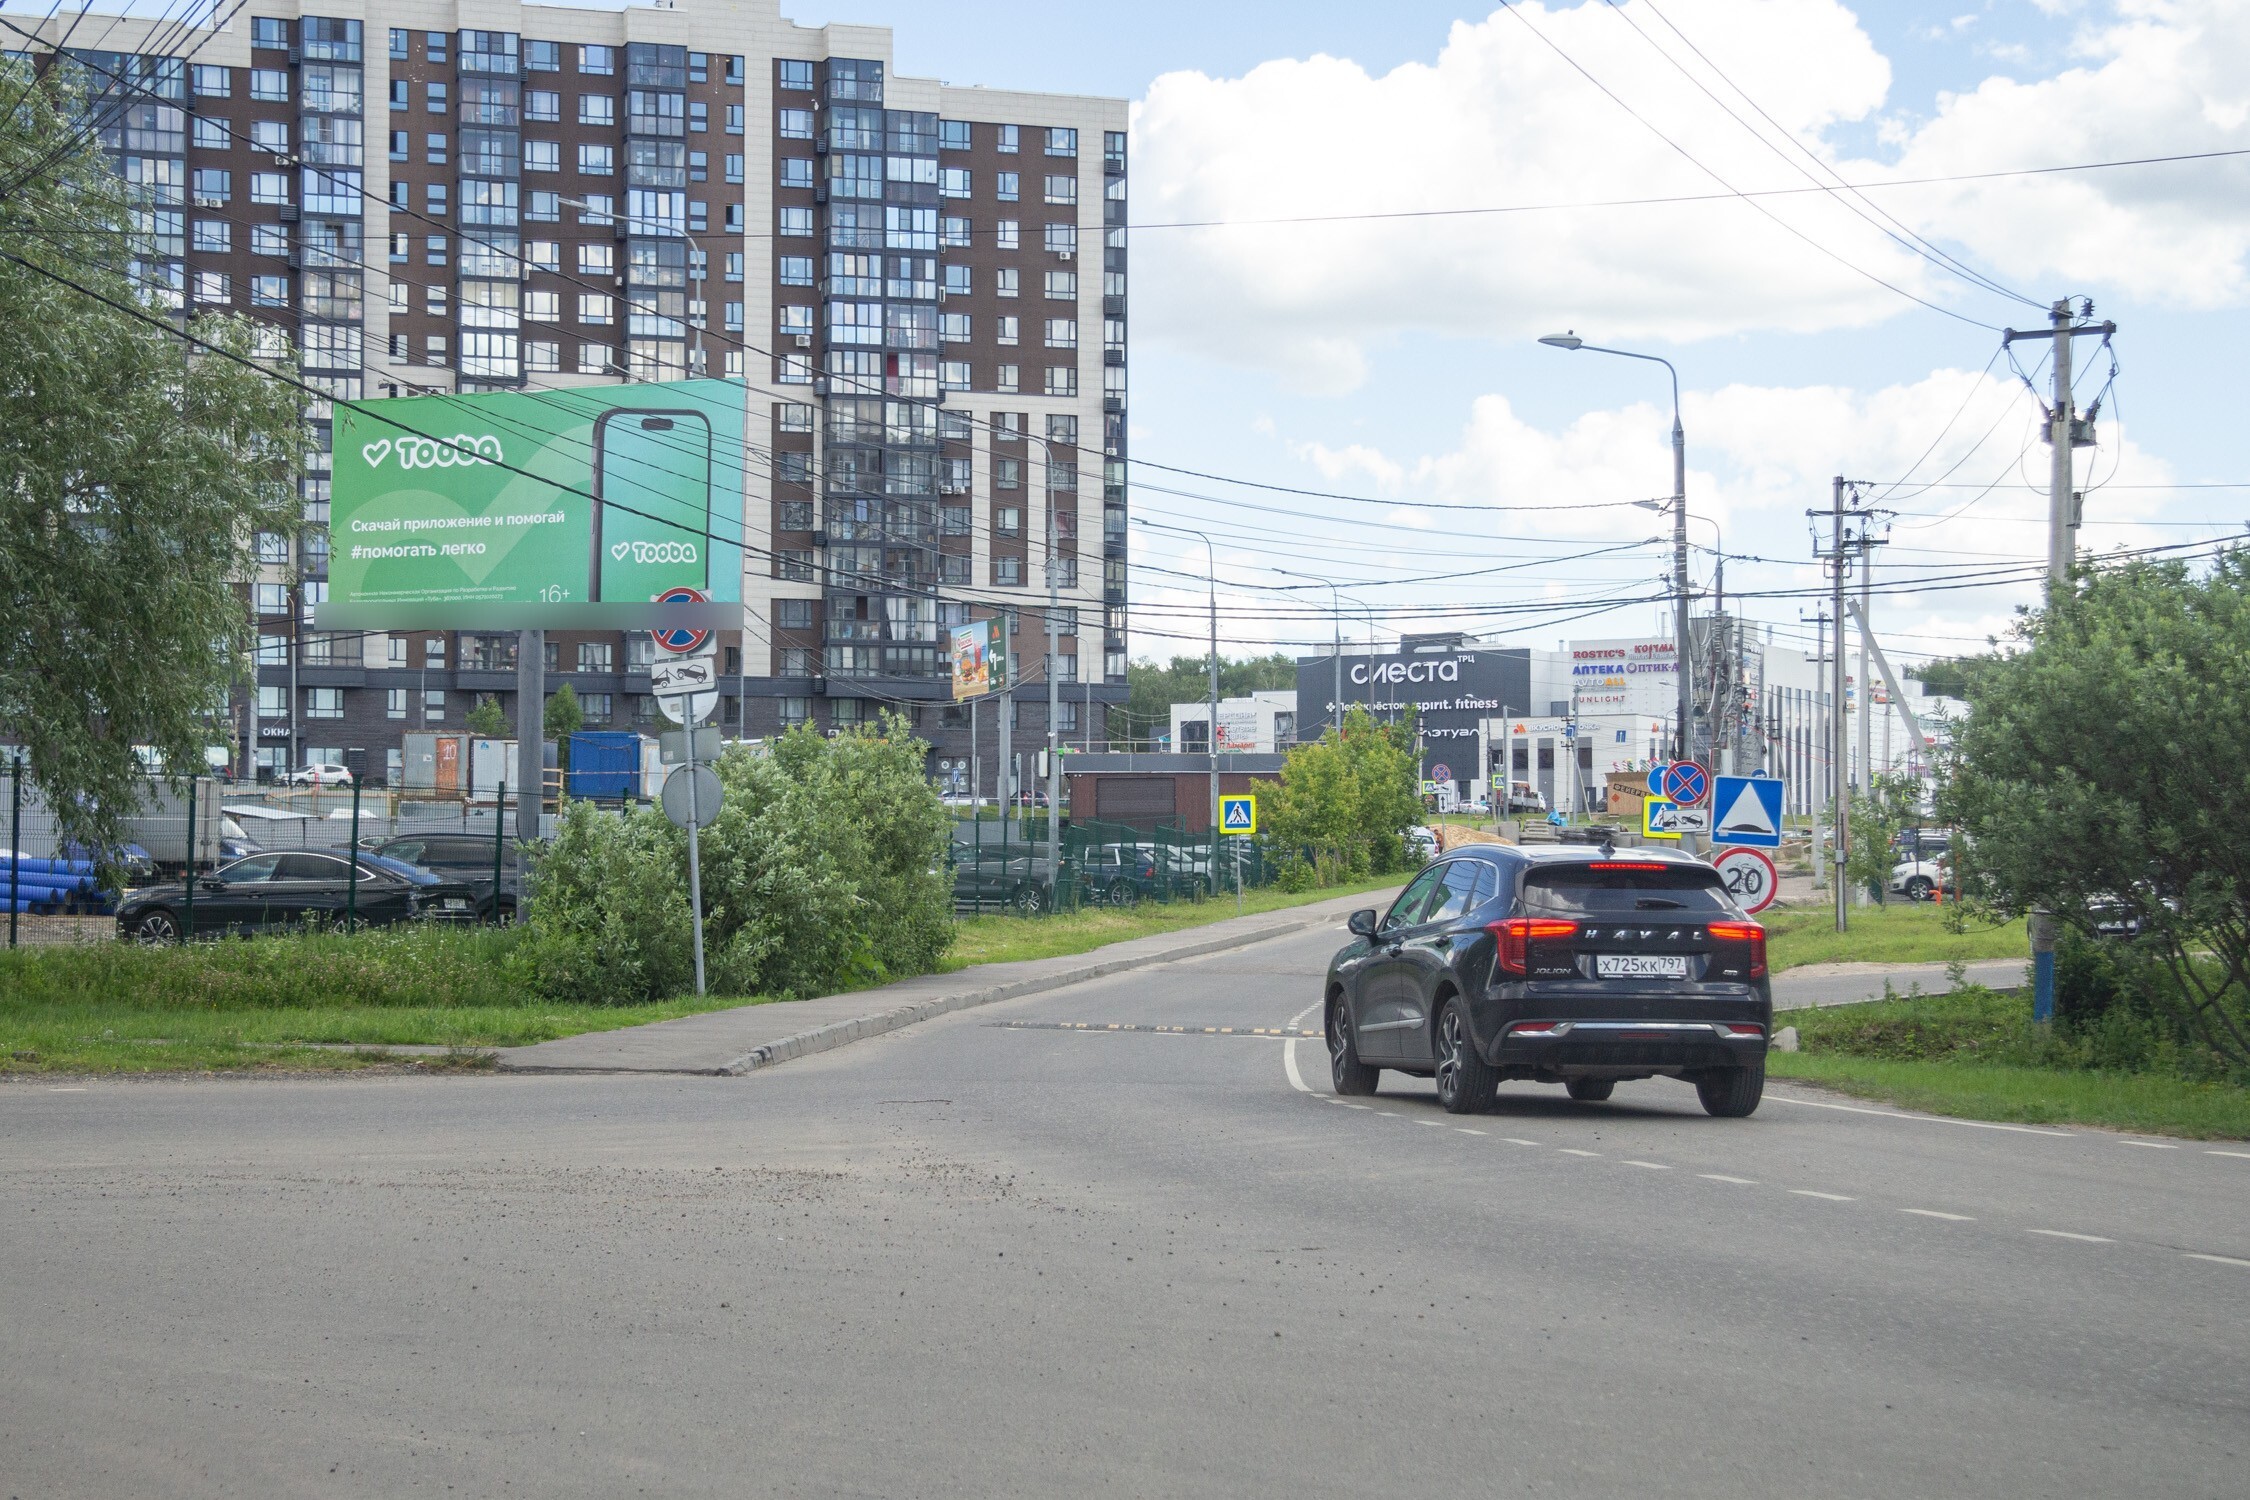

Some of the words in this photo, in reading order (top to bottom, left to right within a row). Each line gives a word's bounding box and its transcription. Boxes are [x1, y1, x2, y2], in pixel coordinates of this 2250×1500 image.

[351, 519, 400, 532] Скачай
[403, 517, 491, 532] приложение
[494, 516, 503, 526] и
[507, 511, 565, 525] помогай
[351, 544, 436, 559] #помогать
[440, 542, 486, 556] легко
[632, 541, 697, 563] Tooba
[539, 584, 571, 602] 16+
[1457, 655, 1475, 664] ТРЦ
[1573, 649, 1626, 659] ROSTIC'S
[1572, 664, 1625, 675] АПТЕКА
[1455, 698, 1498, 710] fitness
[262, 728, 291, 737] ОКНА
[443, 744, 457, 760] 10
[1727, 867, 1763, 894] 20
[1584, 929, 1702, 940] HAVAL
[1660, 957, 1682, 969] 797
[1534, 967, 1571, 975] JOLION
